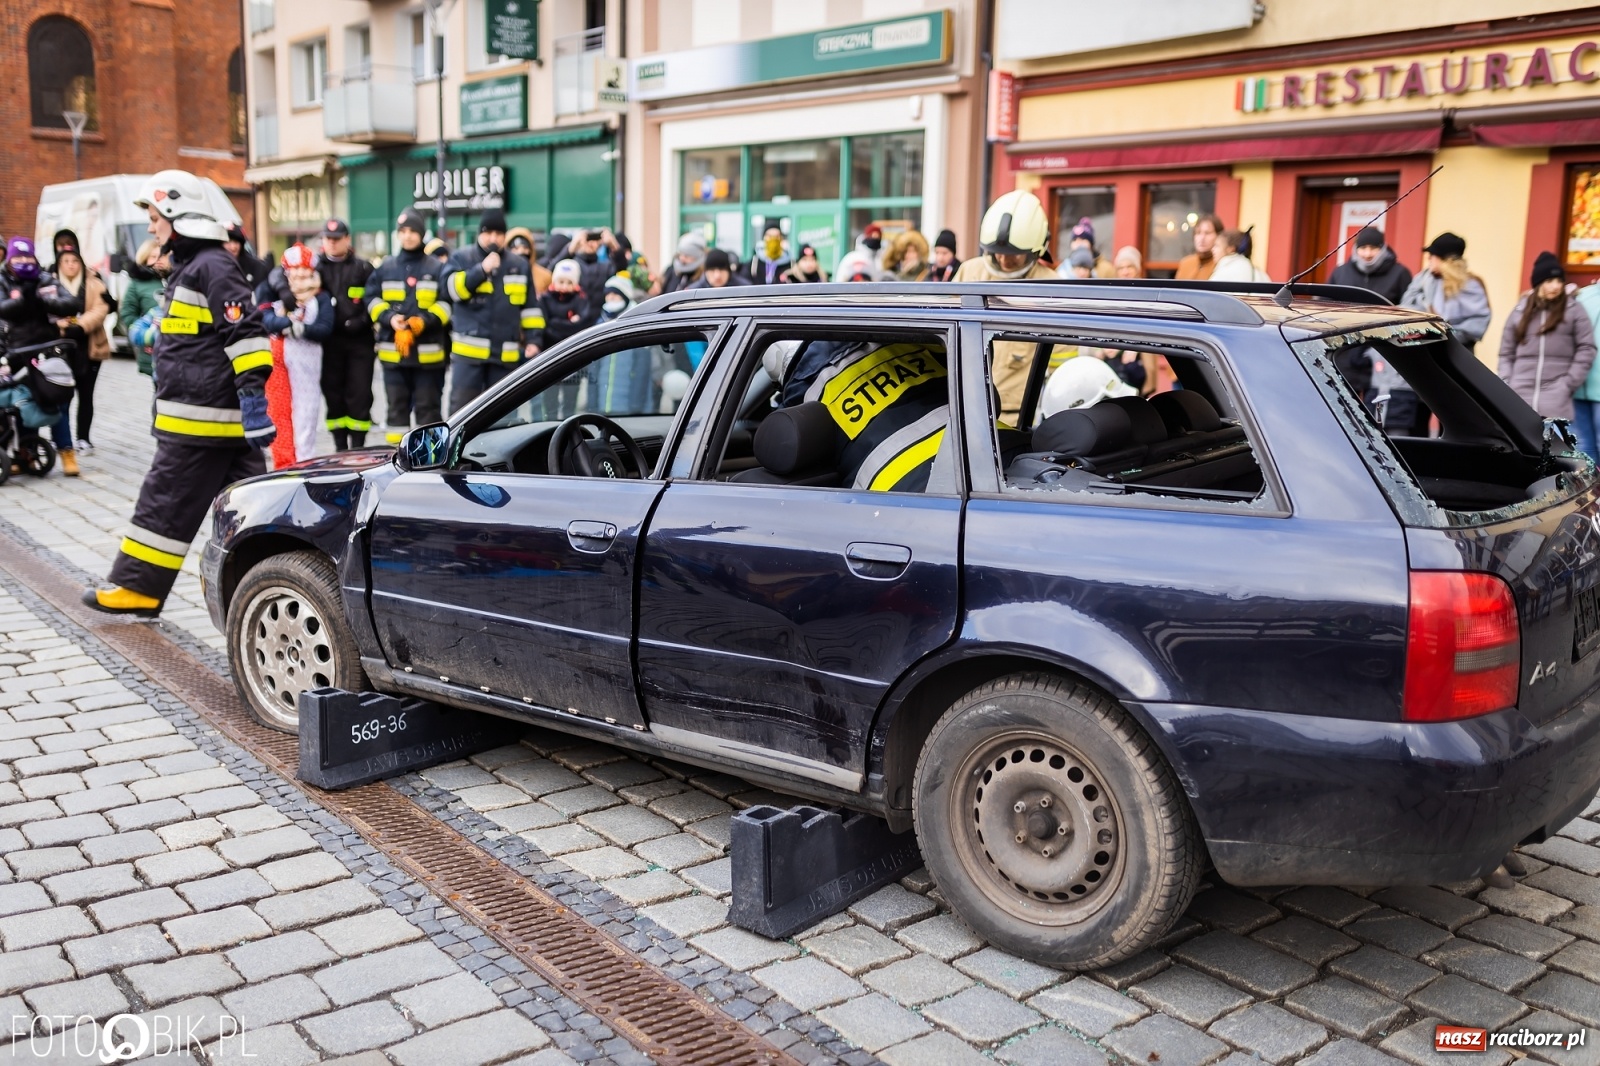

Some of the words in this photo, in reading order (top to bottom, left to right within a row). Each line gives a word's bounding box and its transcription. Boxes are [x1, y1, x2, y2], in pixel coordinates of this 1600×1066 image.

[1282, 42, 1598, 107] RESTAURAC
[413, 166, 504, 198] JUBILER
[1529, 661, 1557, 686] A4
[351, 712, 407, 744] 569-36
[363, 748, 410, 775] JAWS
[806, 875, 854, 914] JAWS
